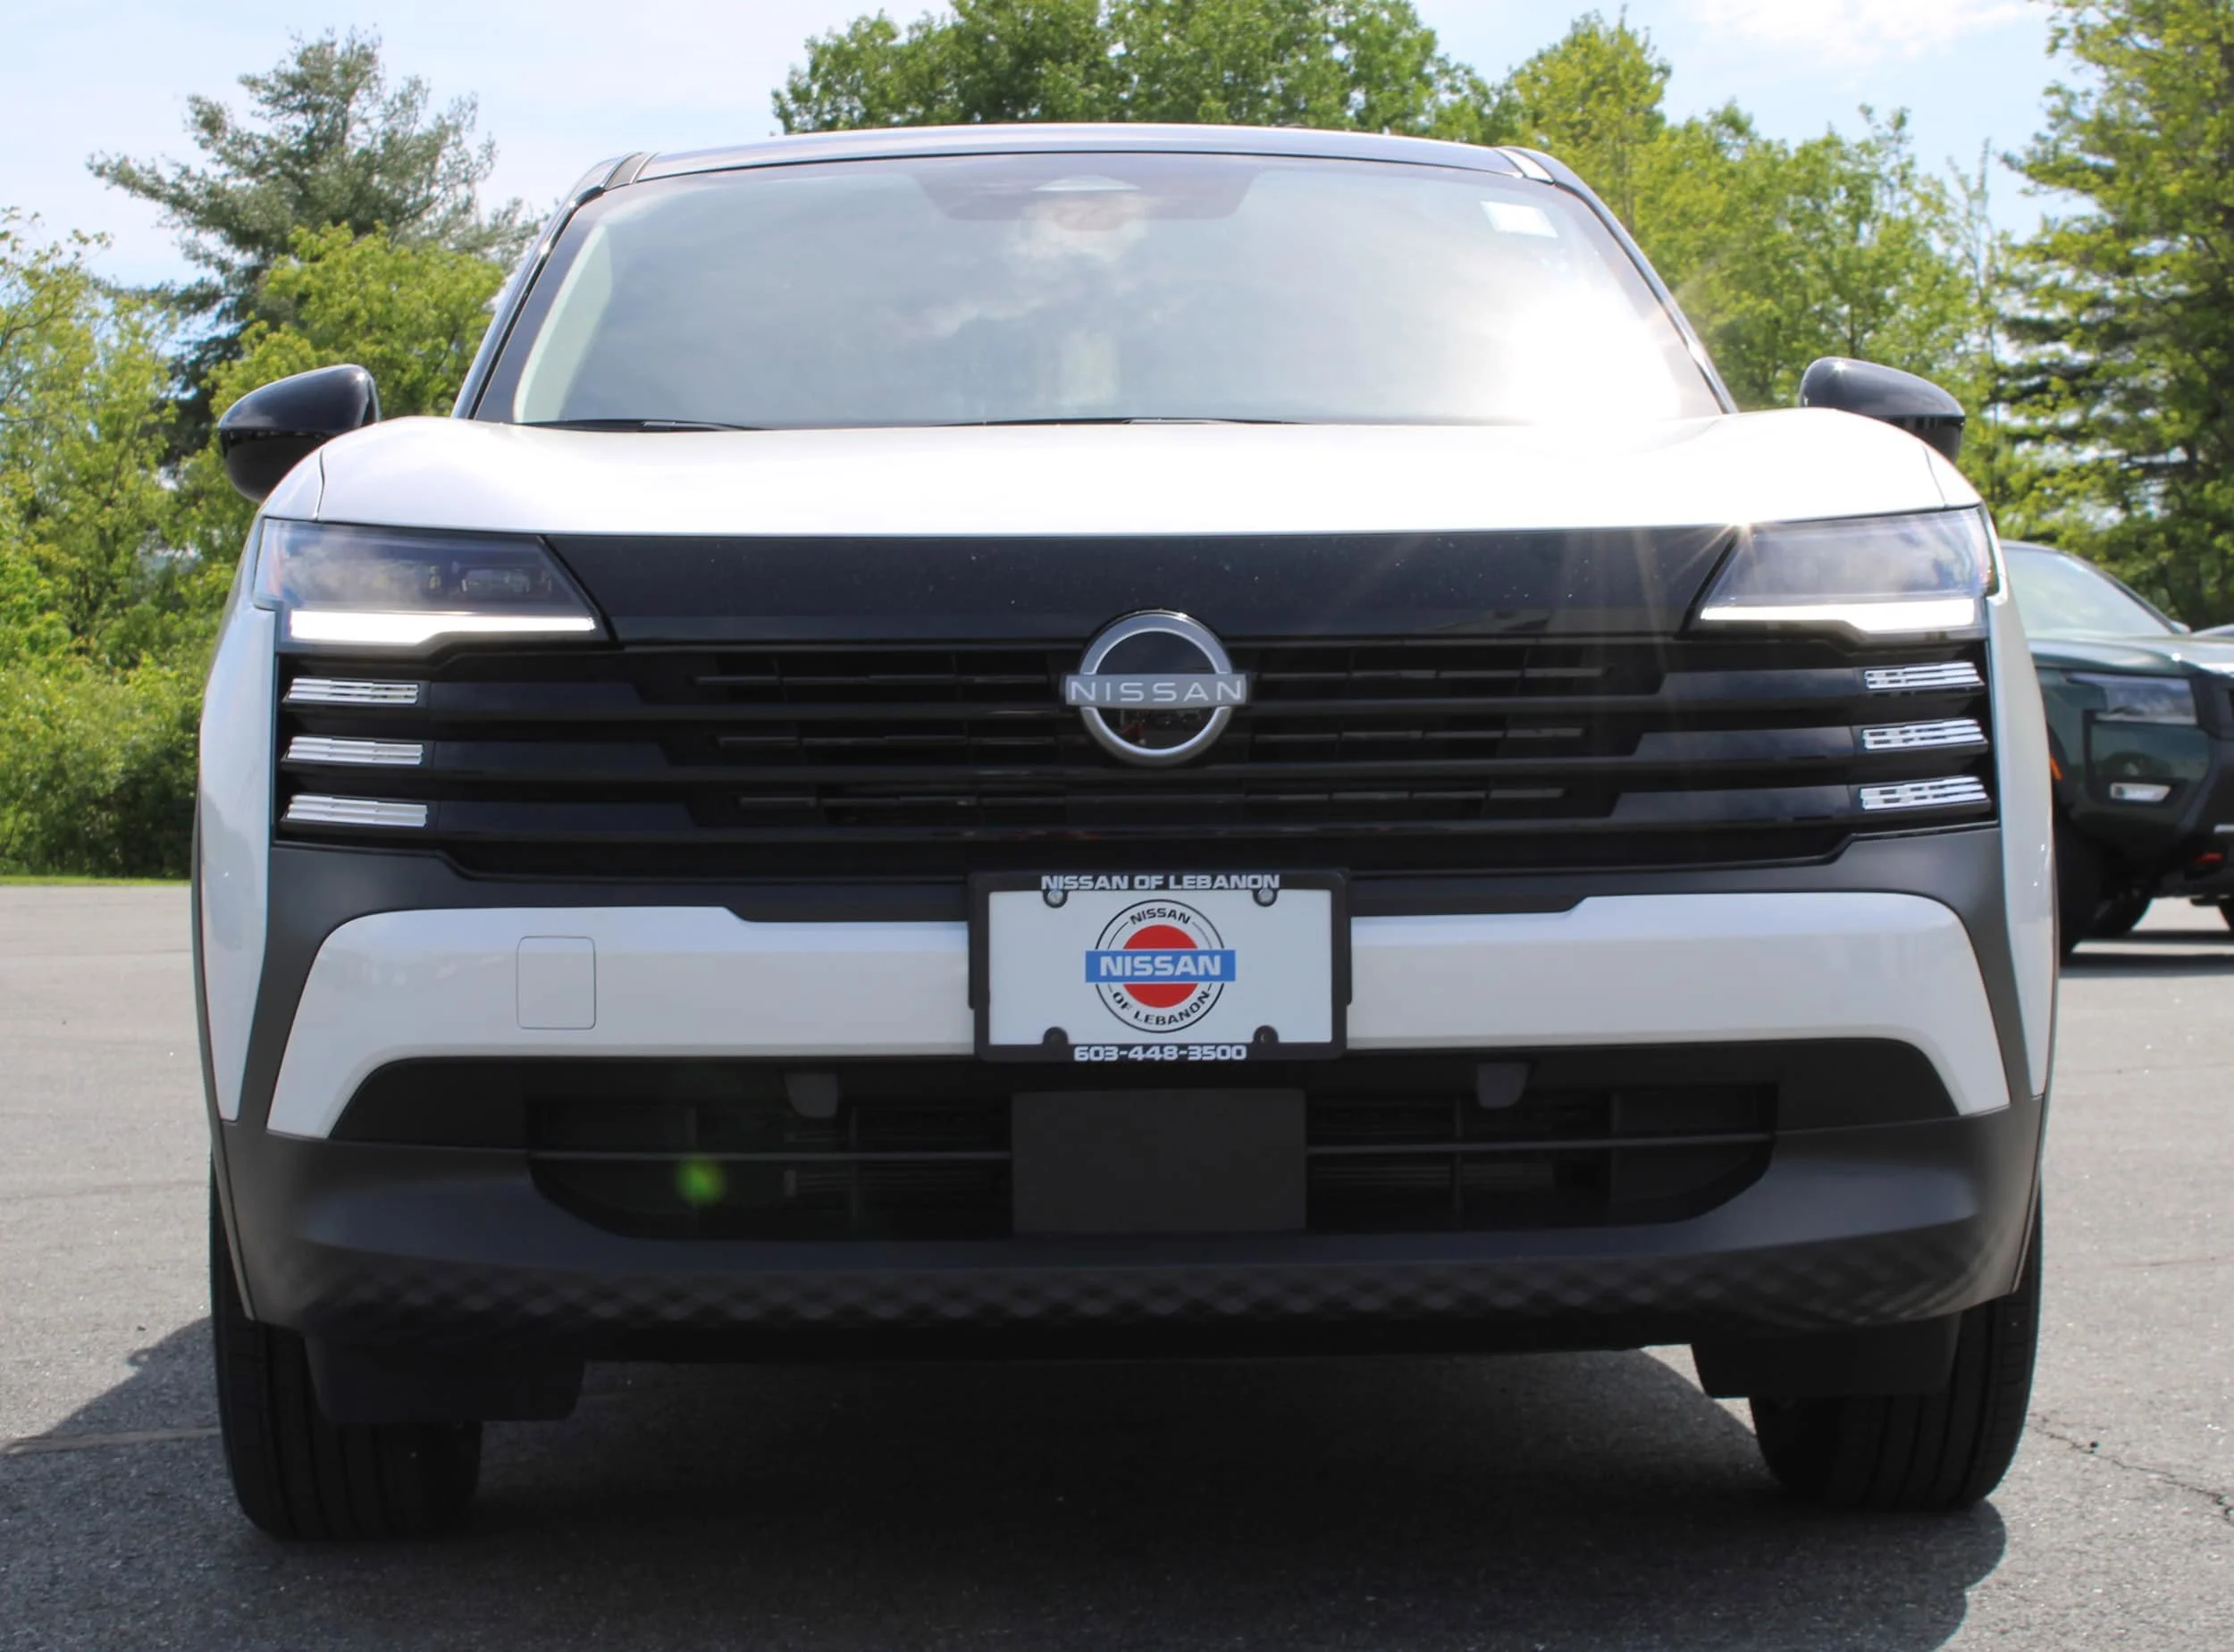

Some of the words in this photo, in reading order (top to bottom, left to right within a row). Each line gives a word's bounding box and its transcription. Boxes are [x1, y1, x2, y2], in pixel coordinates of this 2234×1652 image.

[1071, 680, 1241, 702] NISSAN
[1041, 875, 1129, 891] NISSAN
[1133, 875, 1164, 890] OF
[1169, 874, 1281, 890] LEBANON
[1130, 907, 1191, 926] NISSAN
[1099, 954, 1222, 977] NISSAN
[1112, 990, 1131, 1011] OF
[1133, 990, 1211, 1027] LEBANON
[1073, 1044, 1247, 1061] 603-448-3500
